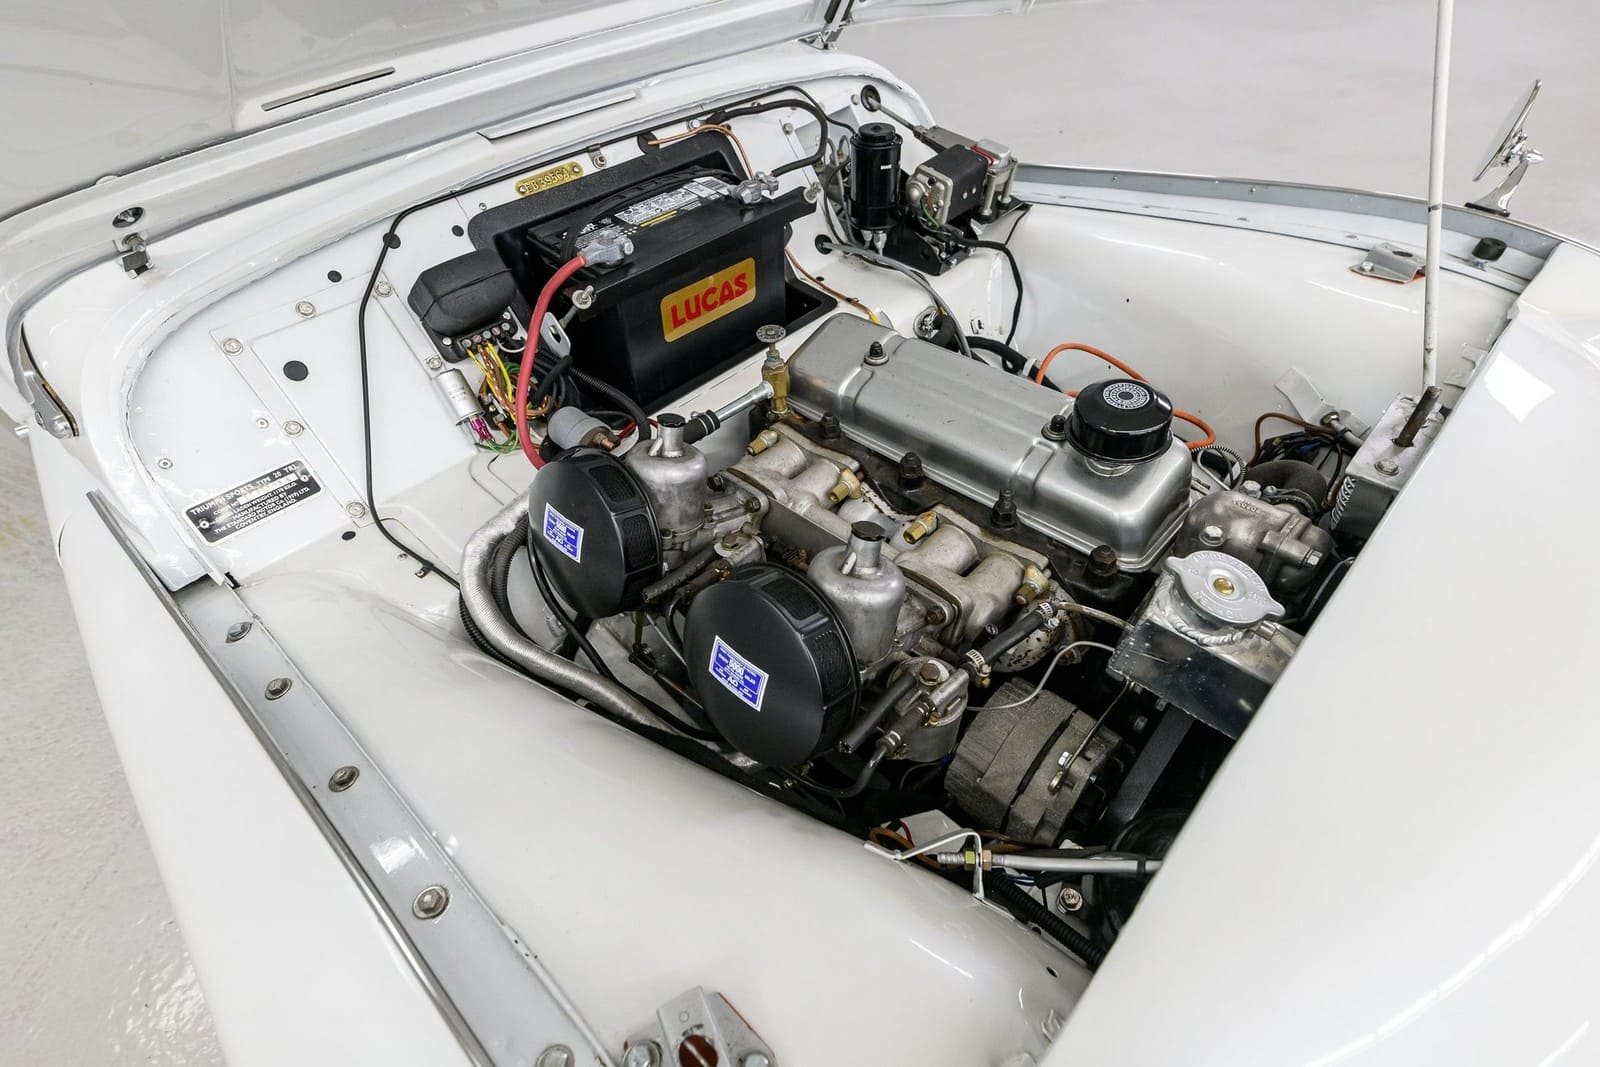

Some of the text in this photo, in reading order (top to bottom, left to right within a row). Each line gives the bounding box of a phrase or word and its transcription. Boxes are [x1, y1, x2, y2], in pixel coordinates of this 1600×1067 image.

[671, 272, 747, 328] LUCAS
[190, 497, 226, 515] TRIUMPH
[257, 477, 271, 486] TYPE
[233, 496, 278, 520] MANUFACTURED
[214, 525, 227, 534] THE
[228, 511, 257, 527] STANDARD
[256, 502, 276, 514] MOTOR
